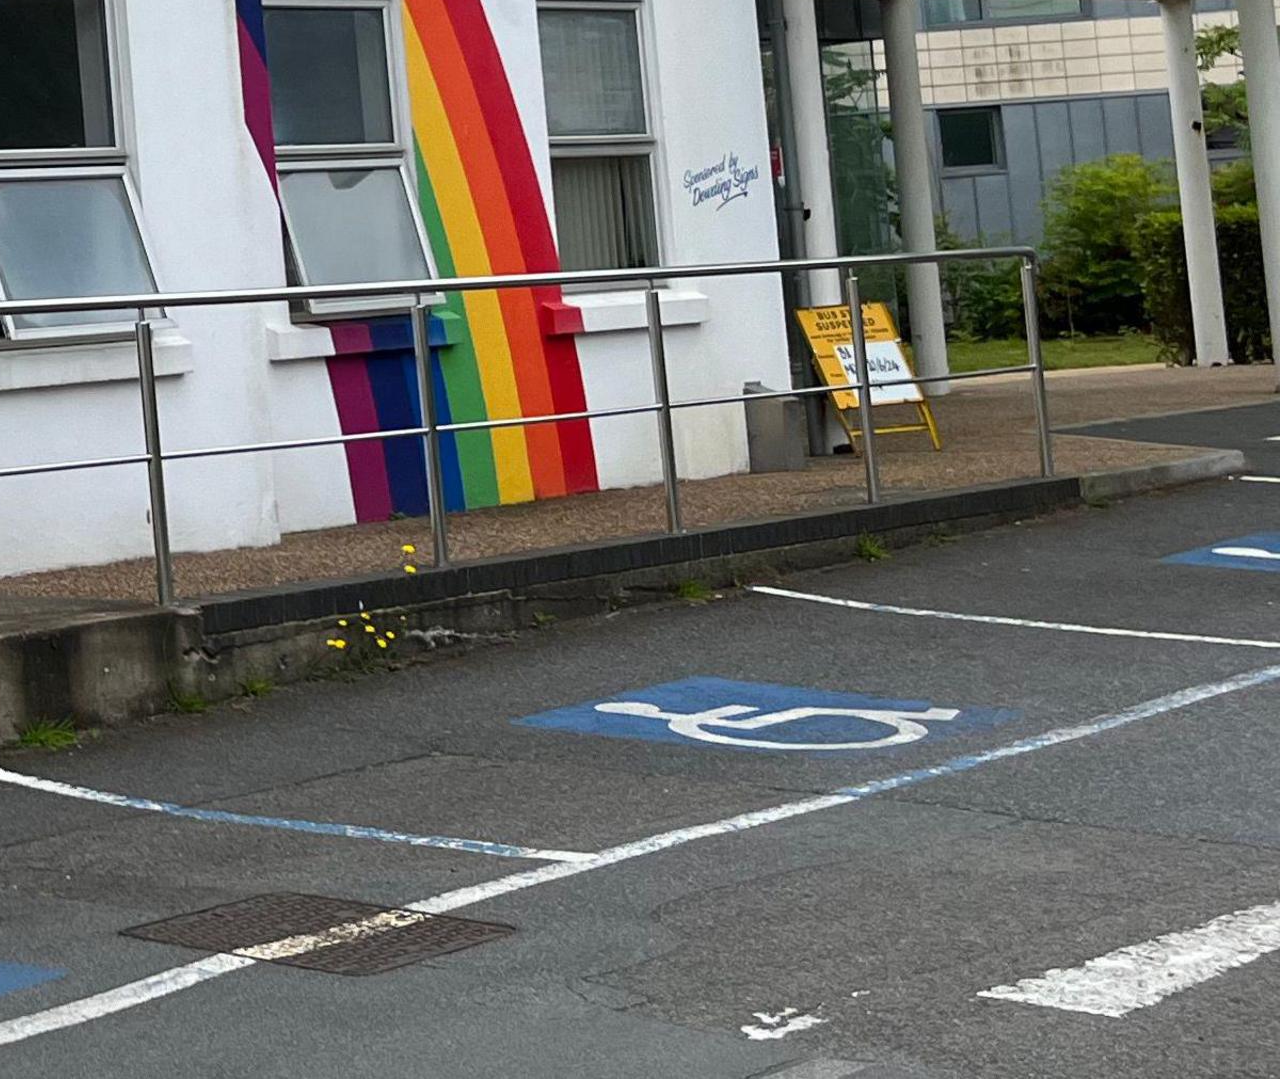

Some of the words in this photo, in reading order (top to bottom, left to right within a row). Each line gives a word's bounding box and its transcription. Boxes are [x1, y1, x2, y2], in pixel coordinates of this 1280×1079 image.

[683, 153, 726, 193] Sponsored
[728, 151, 739, 175] by
[732, 165, 759, 191] Signs
[816, 310, 838, 320] BUS
